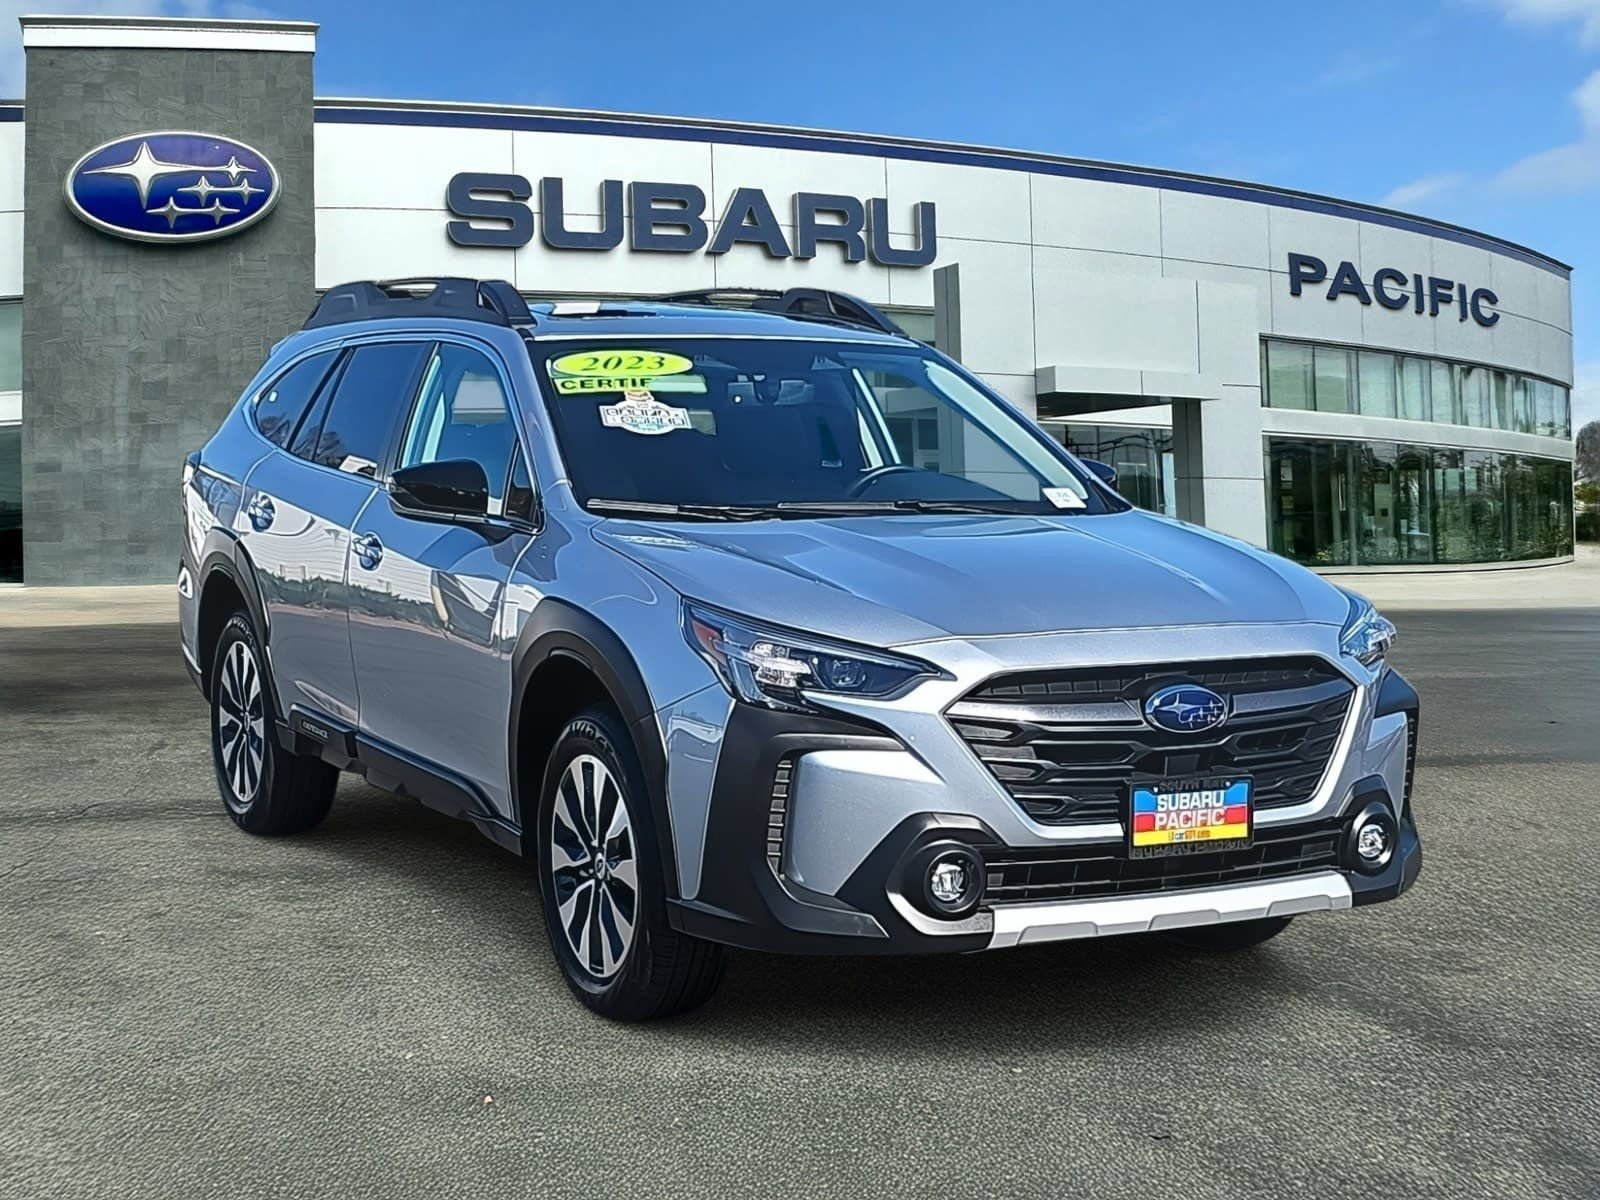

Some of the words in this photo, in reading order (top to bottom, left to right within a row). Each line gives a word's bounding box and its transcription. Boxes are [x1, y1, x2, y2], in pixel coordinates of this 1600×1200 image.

[446, 171, 938, 269] SUBARU
[1288, 252, 1500, 328] PACIFIC
[580, 355, 665, 371] 2023
[1157, 791, 1225, 811] SUBARU
[1154, 808, 1226, 831] PACIFIC
